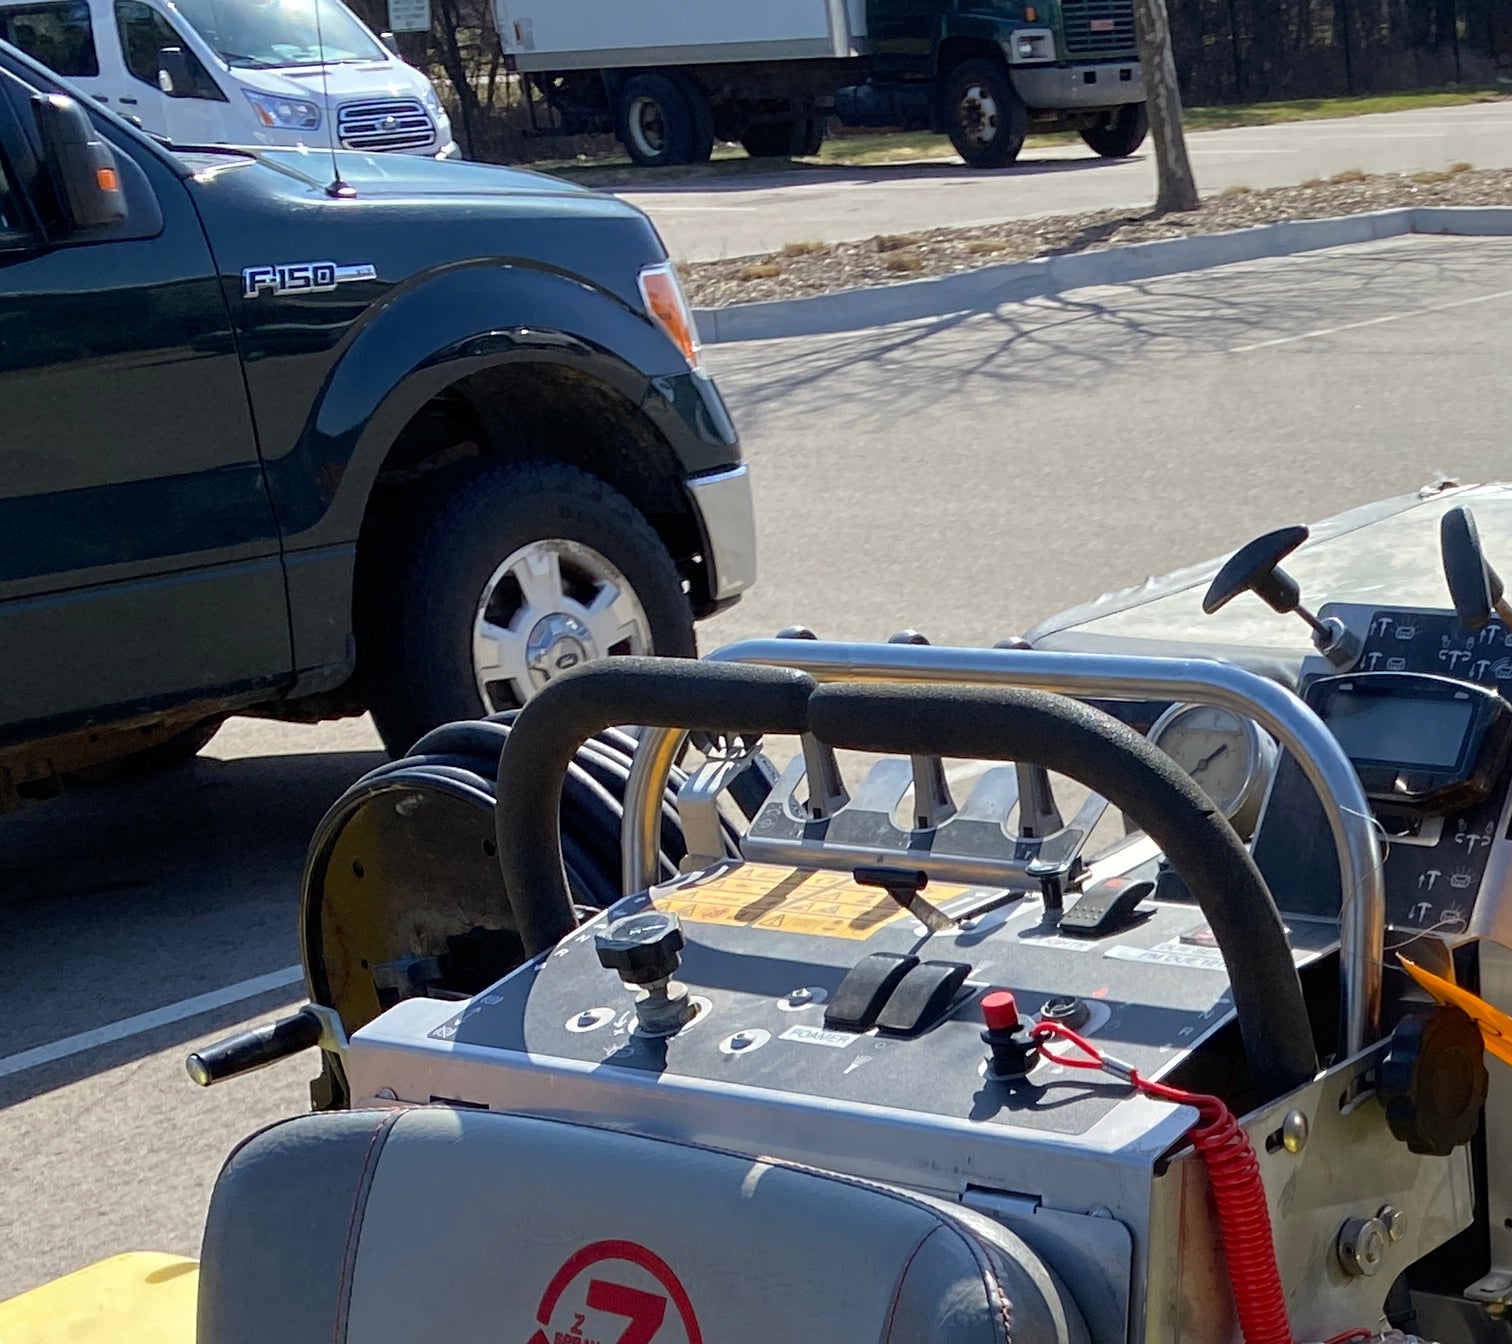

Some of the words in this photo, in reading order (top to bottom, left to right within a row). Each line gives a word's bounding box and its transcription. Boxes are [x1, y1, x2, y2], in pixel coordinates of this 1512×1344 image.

[246, 262, 337, 295] F-150
[788, 1028, 850, 1044] FOAMER
[1178, 1026, 1195, 1036] R
[571, 1313, 586, 1336] Z
